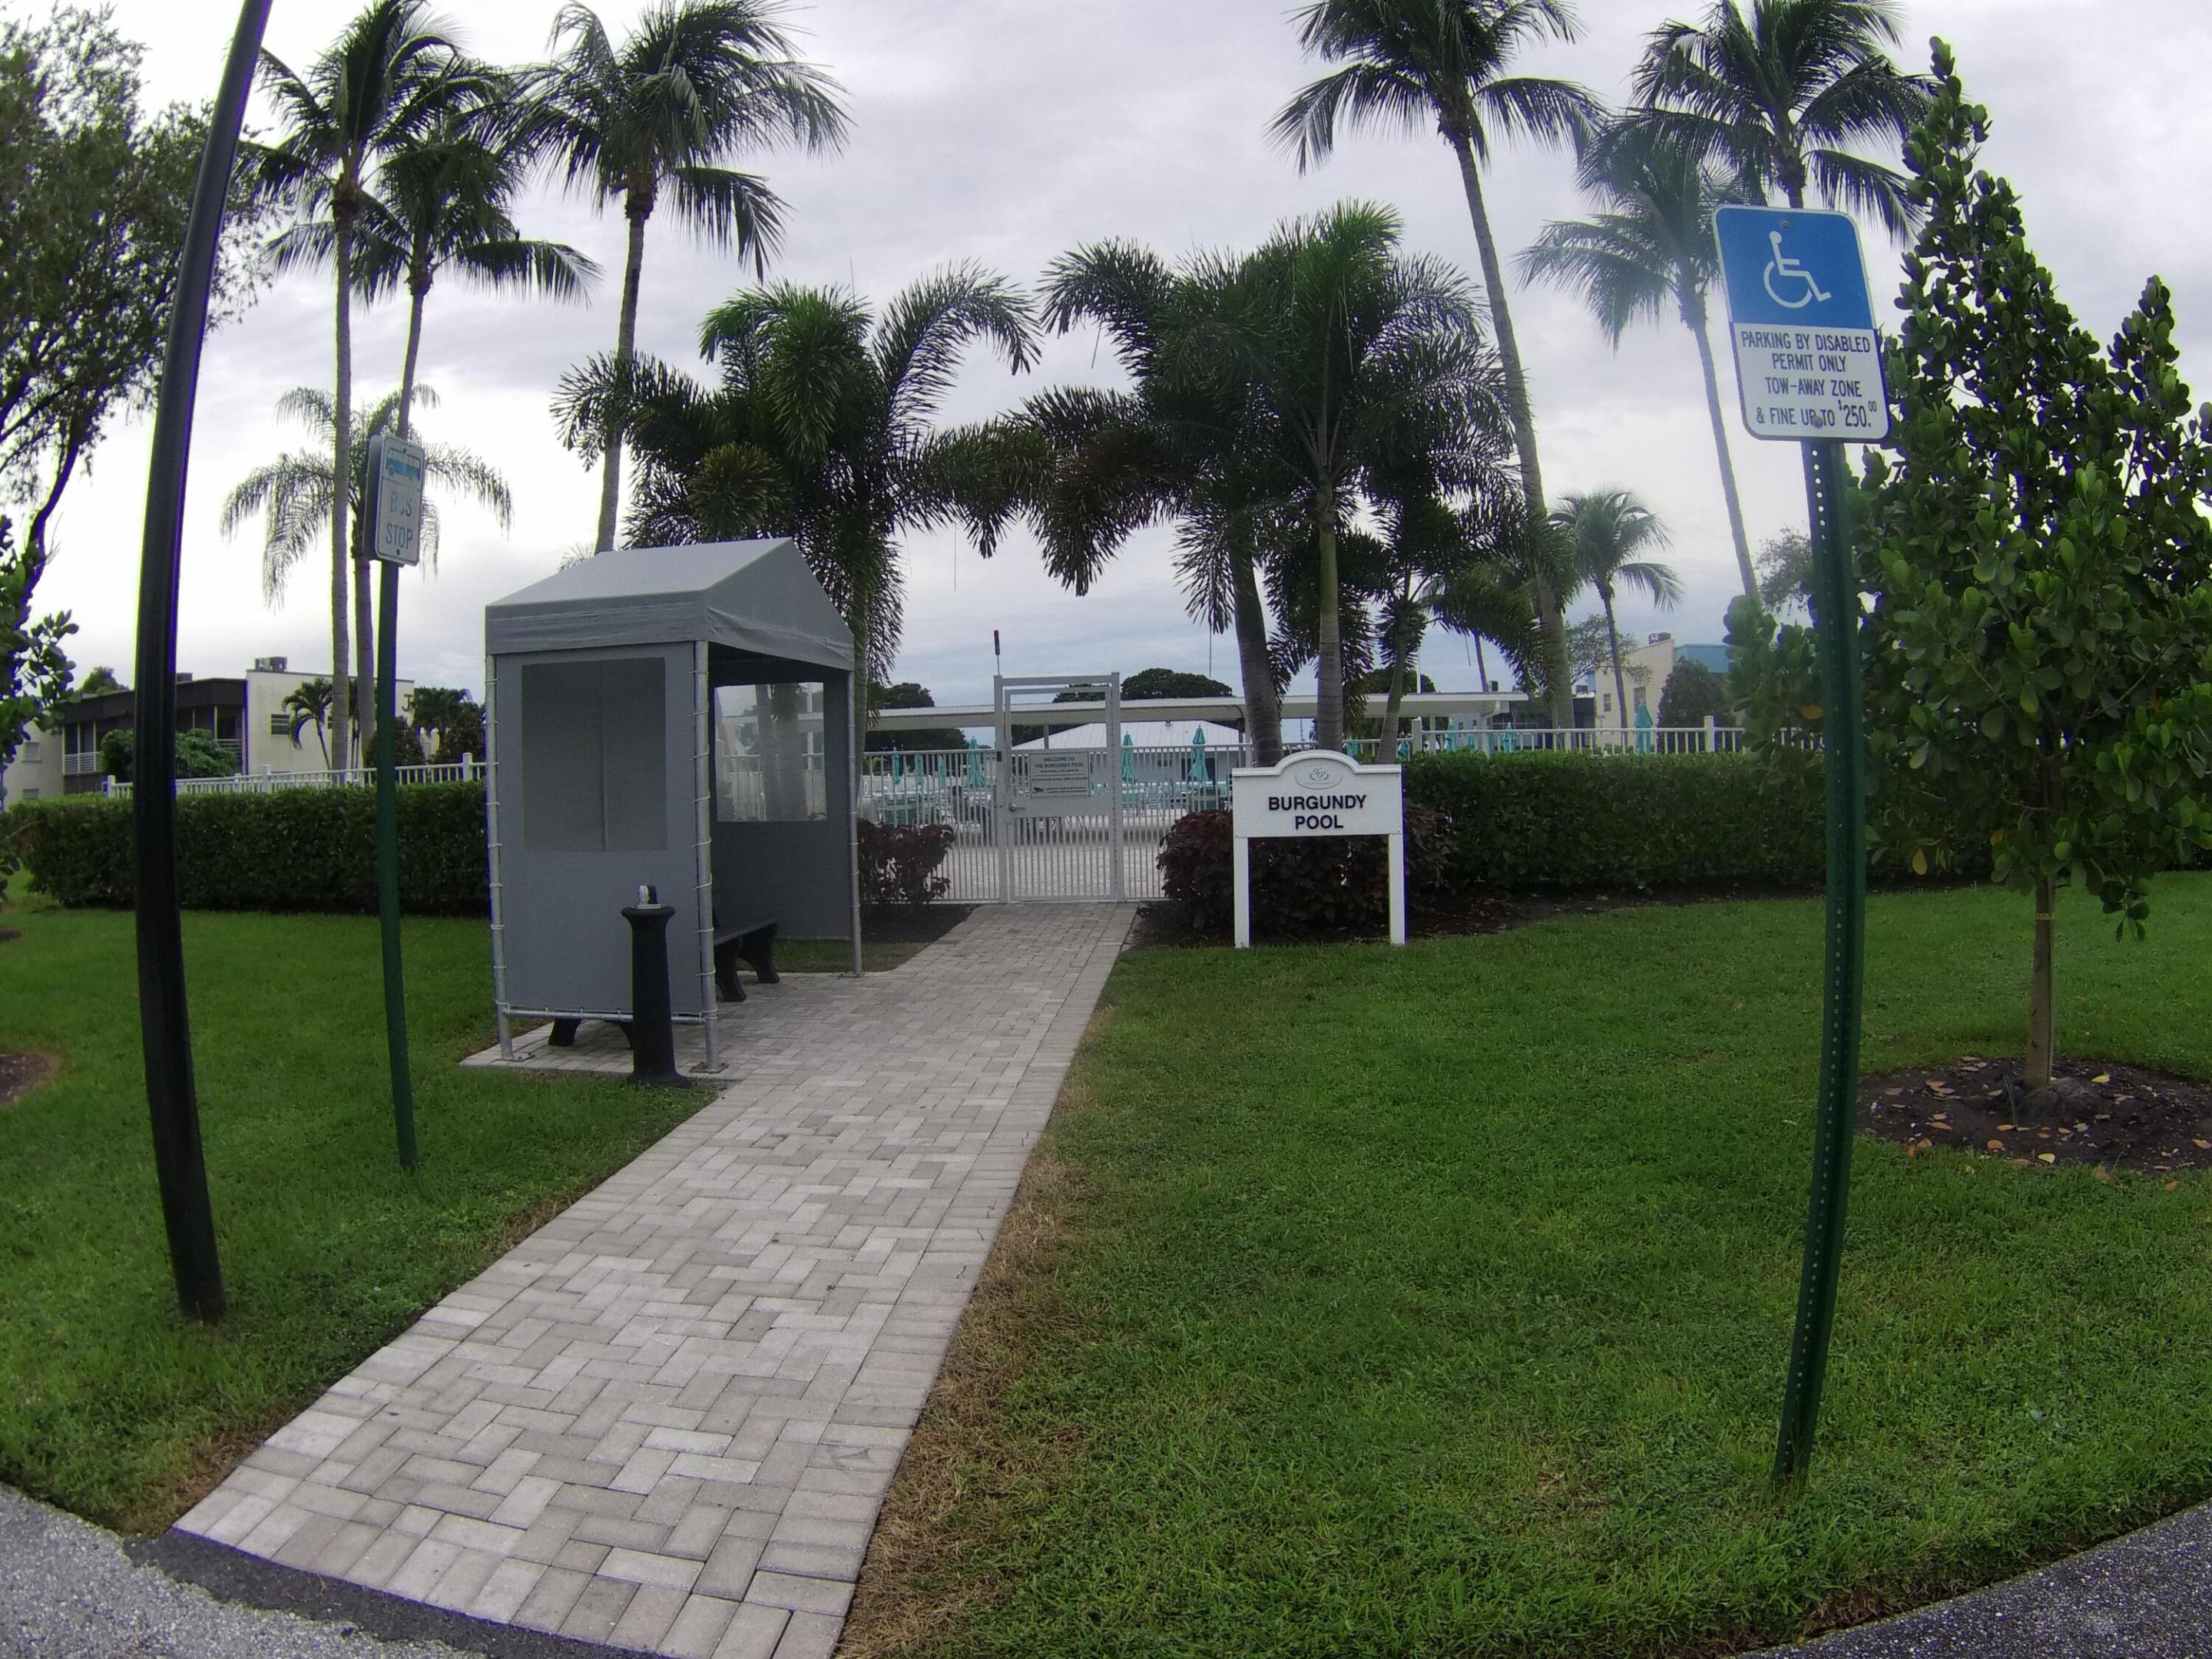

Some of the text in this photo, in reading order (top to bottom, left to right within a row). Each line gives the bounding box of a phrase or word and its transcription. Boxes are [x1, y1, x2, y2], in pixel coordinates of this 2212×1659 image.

[1741, 331, 1870, 353] PARKING BY DISABLED
[1772, 353, 1846, 373] PERMIT ONLY
[1764, 377, 1863, 397] TOW-AWAY ZONE
[1756, 406, 1765, 424] &
[1770, 407, 1797, 426] FINE
[1800, 408, 1817, 426] UP
[1820, 409, 1836, 427] TO
[386, 523, 413, 549] STOP
[1268, 794, 1367, 811] BURGUNDY
[1295, 815, 1344, 830] POOL
